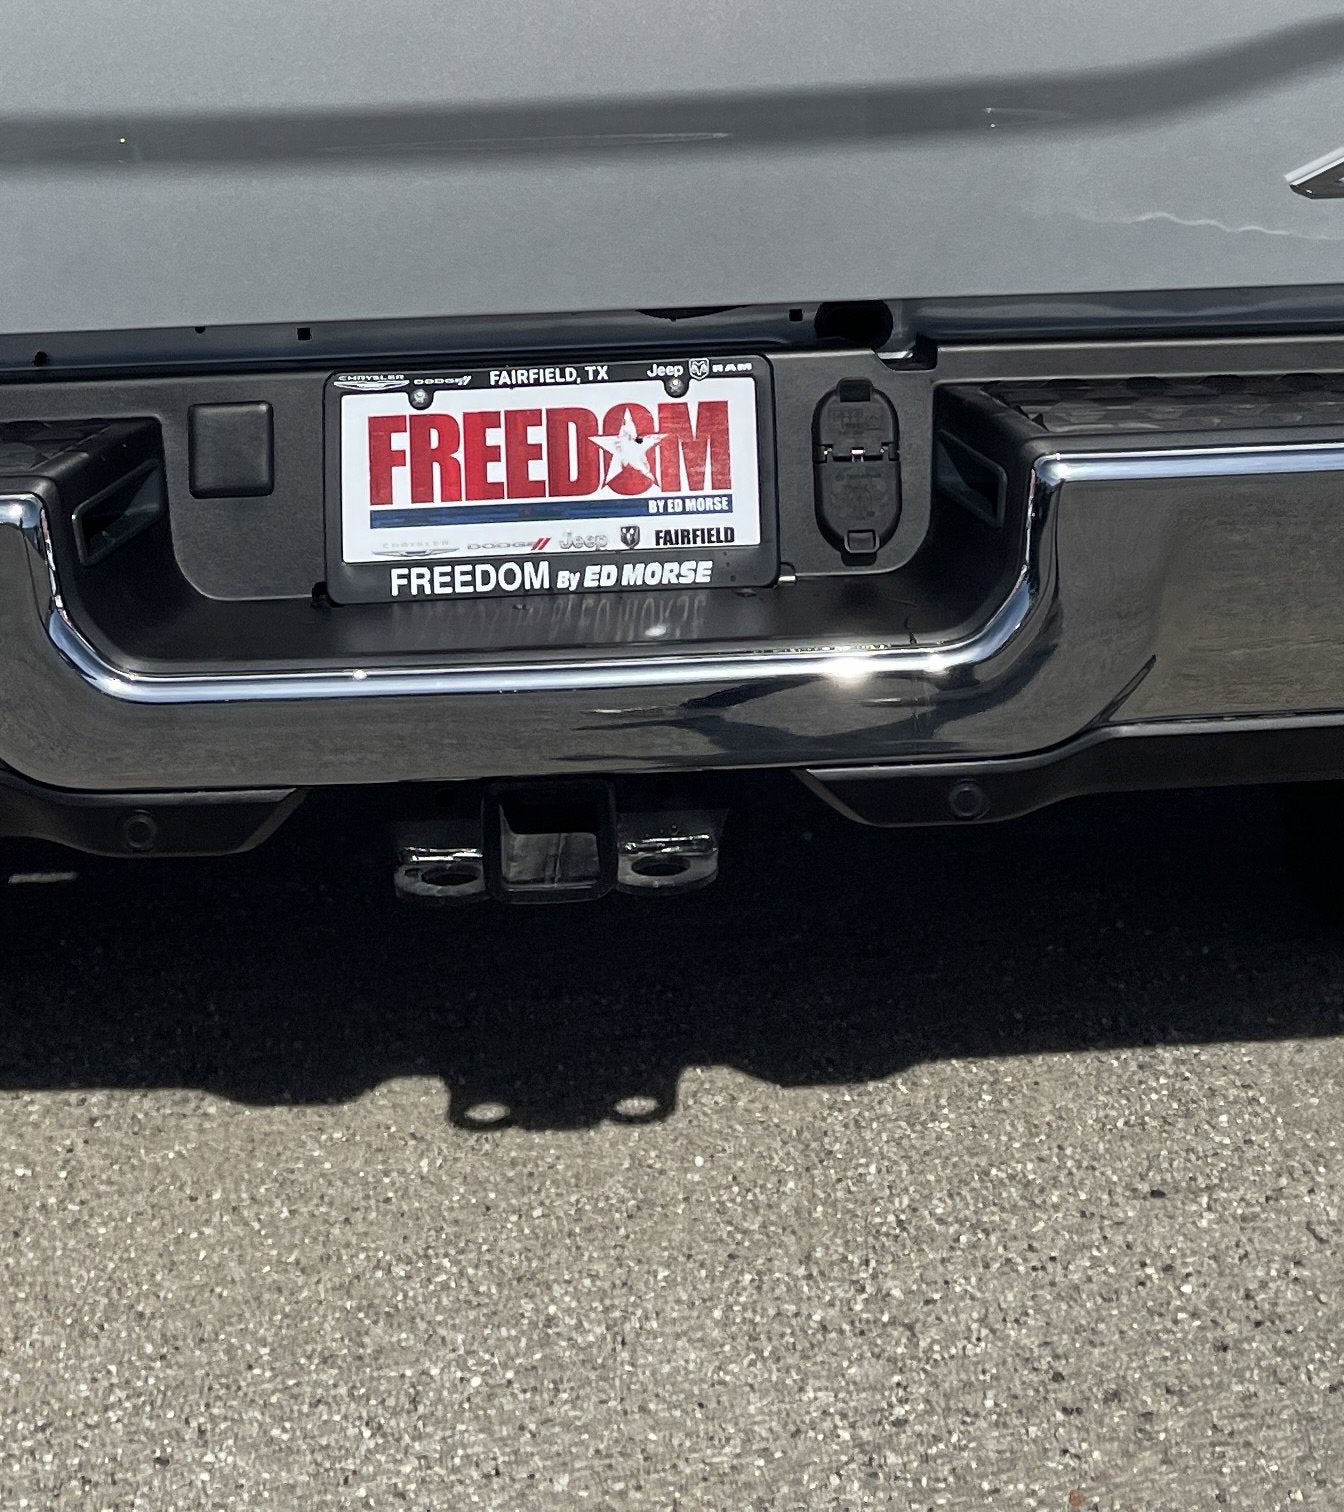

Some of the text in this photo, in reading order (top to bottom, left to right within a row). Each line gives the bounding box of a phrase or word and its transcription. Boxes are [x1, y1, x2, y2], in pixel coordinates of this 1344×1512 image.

[338, 374, 405, 382] CHRYSLER
[489, 367, 581, 386] FAIRFIELD,
[585, 365, 609, 381] TX
[647, 363, 684, 378] Jeep
[712, 363, 752, 373] RAM
[367, 400, 732, 506] FREEDOM
[648, 496, 729, 514] BY ED MORSE
[559, 528, 608, 551] Jeep
[654, 526, 735, 547] FAIRFIELD
[390, 560, 714, 596] FREEDOM By ED MORSE
